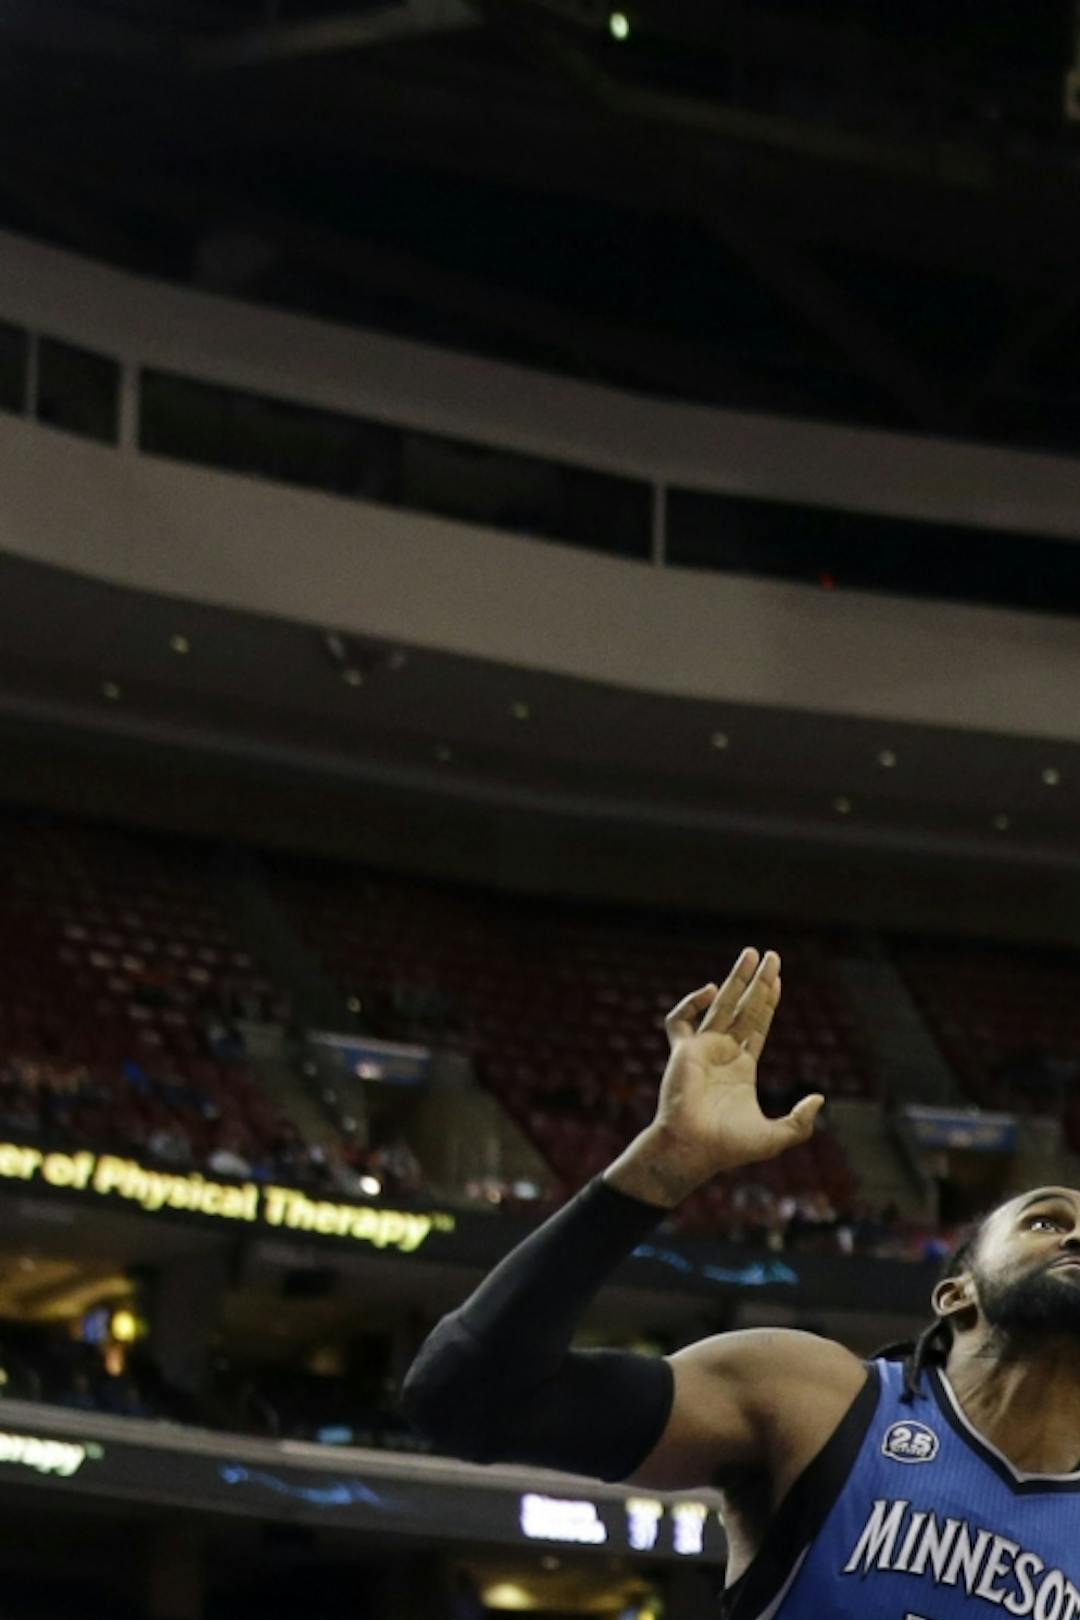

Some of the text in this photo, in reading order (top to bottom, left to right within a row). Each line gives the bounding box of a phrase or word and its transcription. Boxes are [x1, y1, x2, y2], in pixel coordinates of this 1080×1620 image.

[43, 1151, 94, 1190] of
[95, 1154, 258, 1222] Physical
[264, 1184, 431, 1252] Therapy
[890, 1427, 932, 1456] 25
